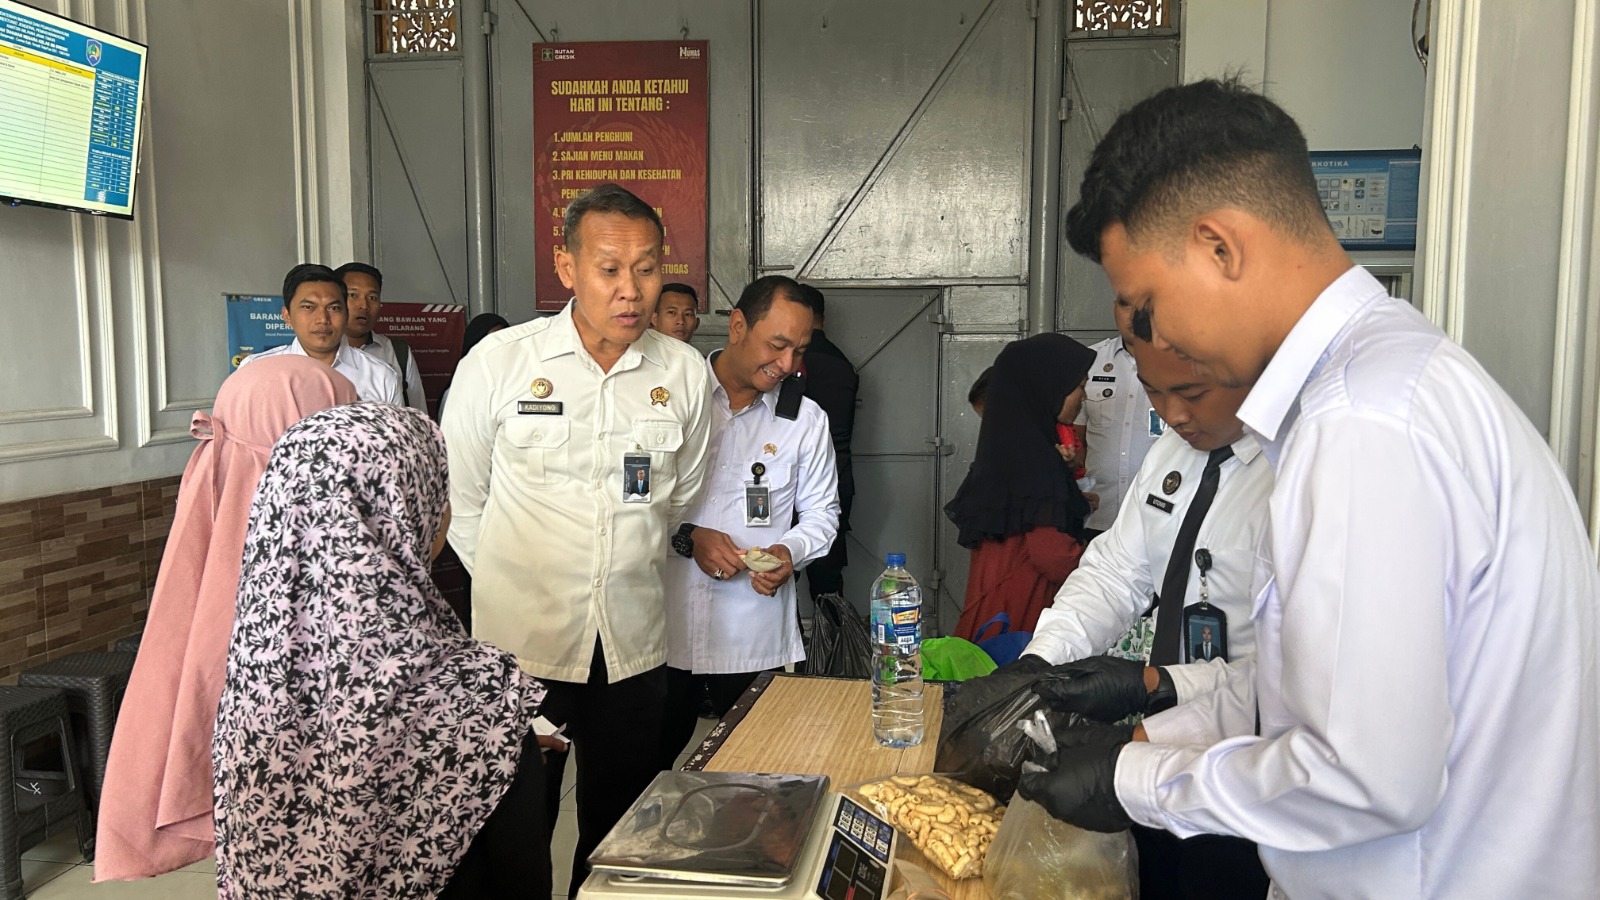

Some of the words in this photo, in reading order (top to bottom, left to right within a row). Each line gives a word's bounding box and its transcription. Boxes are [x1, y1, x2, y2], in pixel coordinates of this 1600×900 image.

[551, 80, 609, 96] SUDAHKAH
[611, 80, 641, 95] ANDA
[644, 79, 689, 94] KETAHUI
[569, 97, 595, 113] HARI
[598, 97, 613, 112] INI
[615, 96, 663, 112] TENTANG
[595, 132, 633, 142] PENGHUNI
[590, 151, 613, 161] MENU
[615, 150, 644, 161] MAKAN
[575, 170, 618, 180] KEHIDUPAN
[620, 169, 636, 180] DAN
[638, 169, 682, 180] KESEHATAN
[661, 263, 689, 274] ETUGAS
